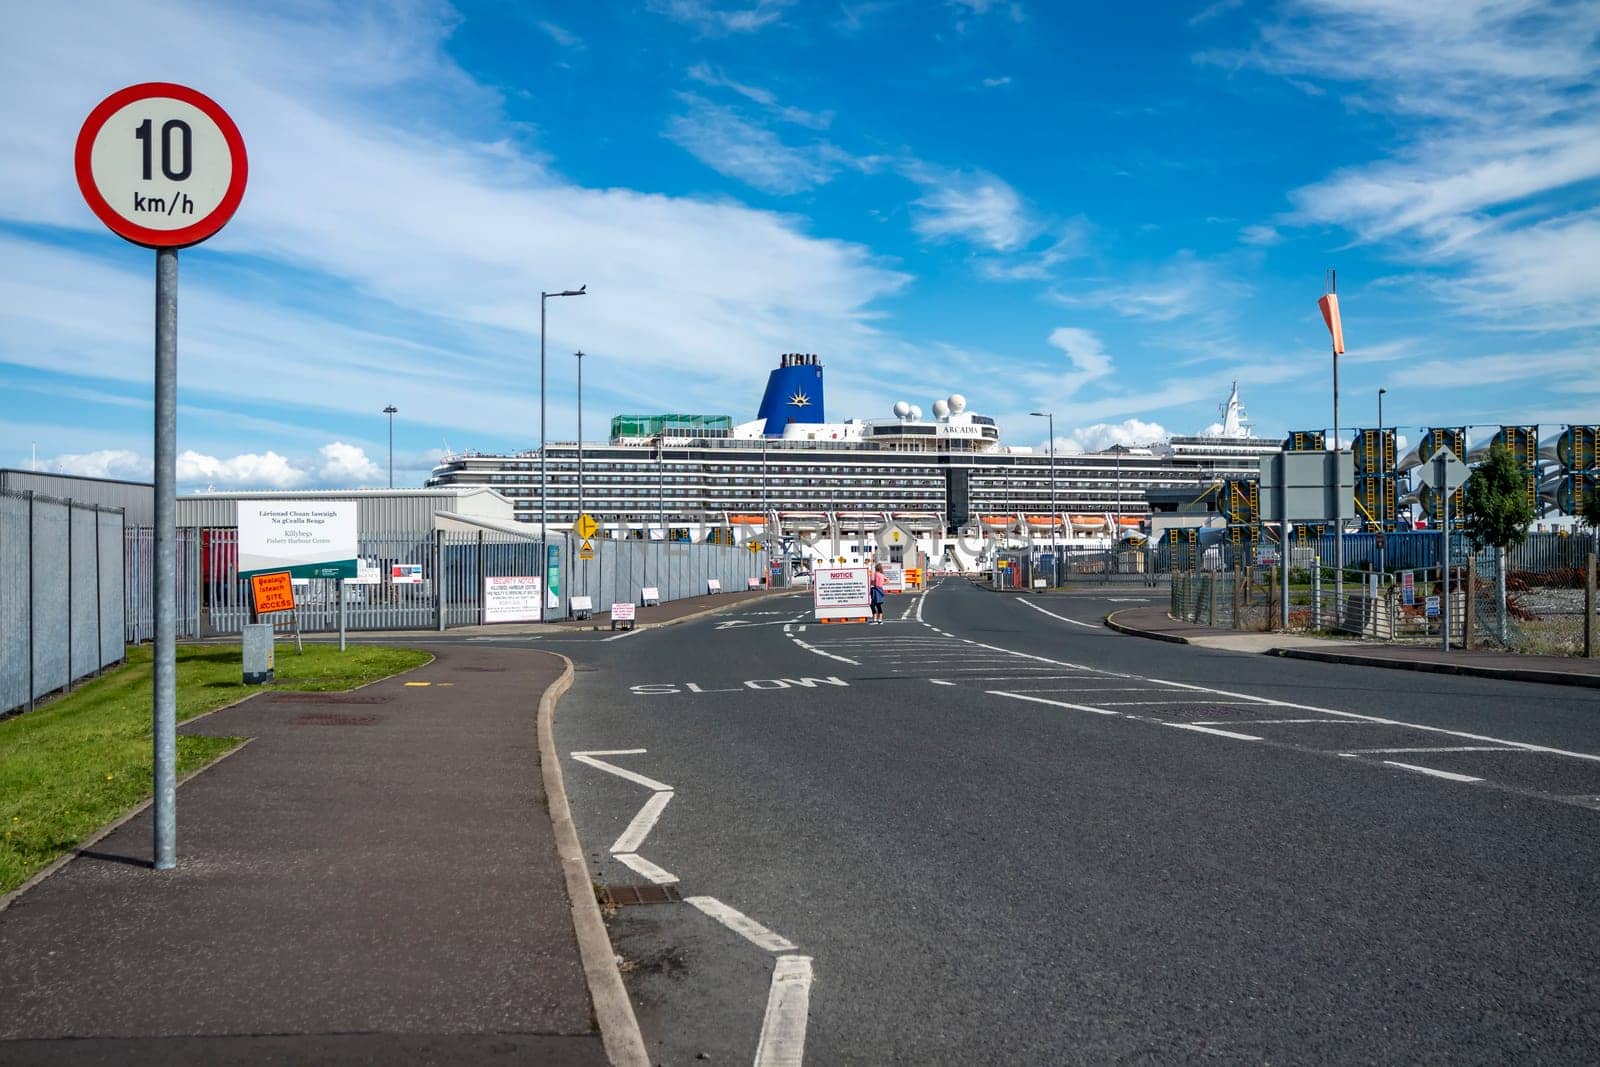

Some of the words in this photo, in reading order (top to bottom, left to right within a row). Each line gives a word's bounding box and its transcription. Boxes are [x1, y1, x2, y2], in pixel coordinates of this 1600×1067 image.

[135, 119, 193, 182] 10
[134, 191, 194, 216] km/h
[943, 426, 978, 434] ARCADIA
[284, 530, 312, 538] Killybegs
[266, 593, 283, 601] SITE
[259, 600, 291, 609] ACCESS
[629, 676, 850, 695] SLOW
